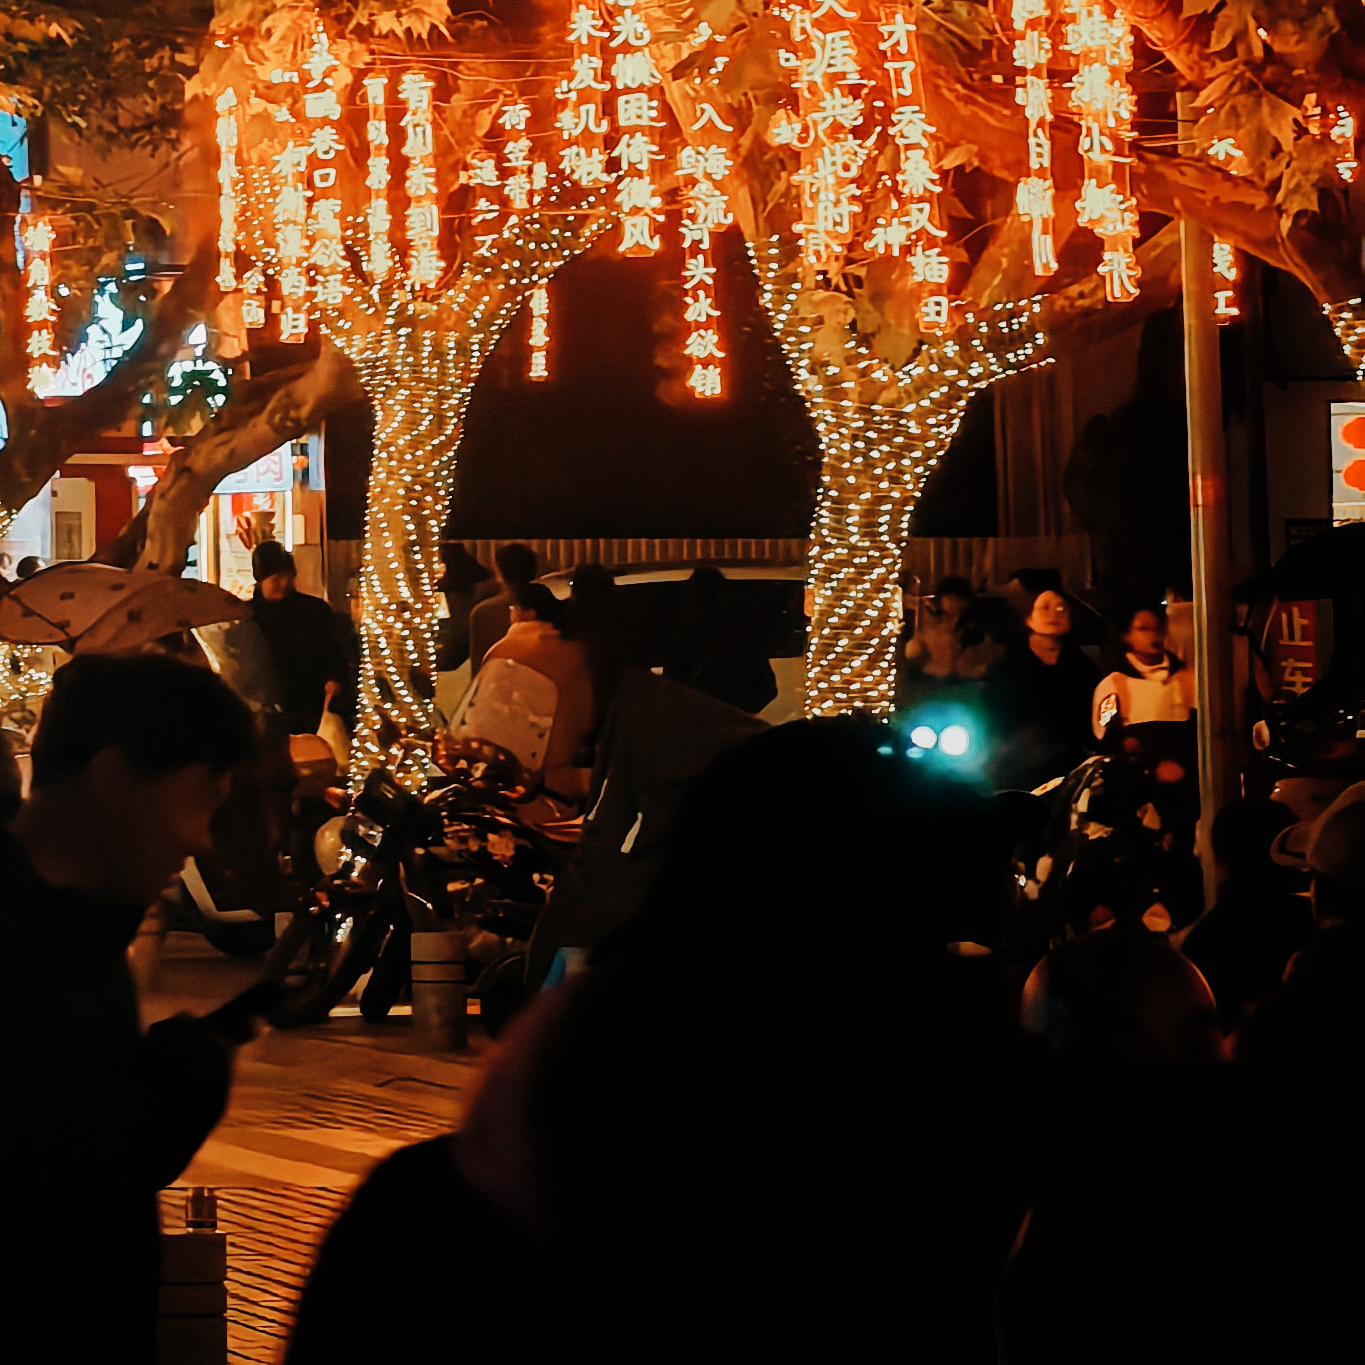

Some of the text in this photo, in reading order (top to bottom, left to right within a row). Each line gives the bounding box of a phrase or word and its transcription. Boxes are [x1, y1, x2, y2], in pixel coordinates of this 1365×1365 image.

[878, 14, 949, 324] 才了蚕桑又插田
